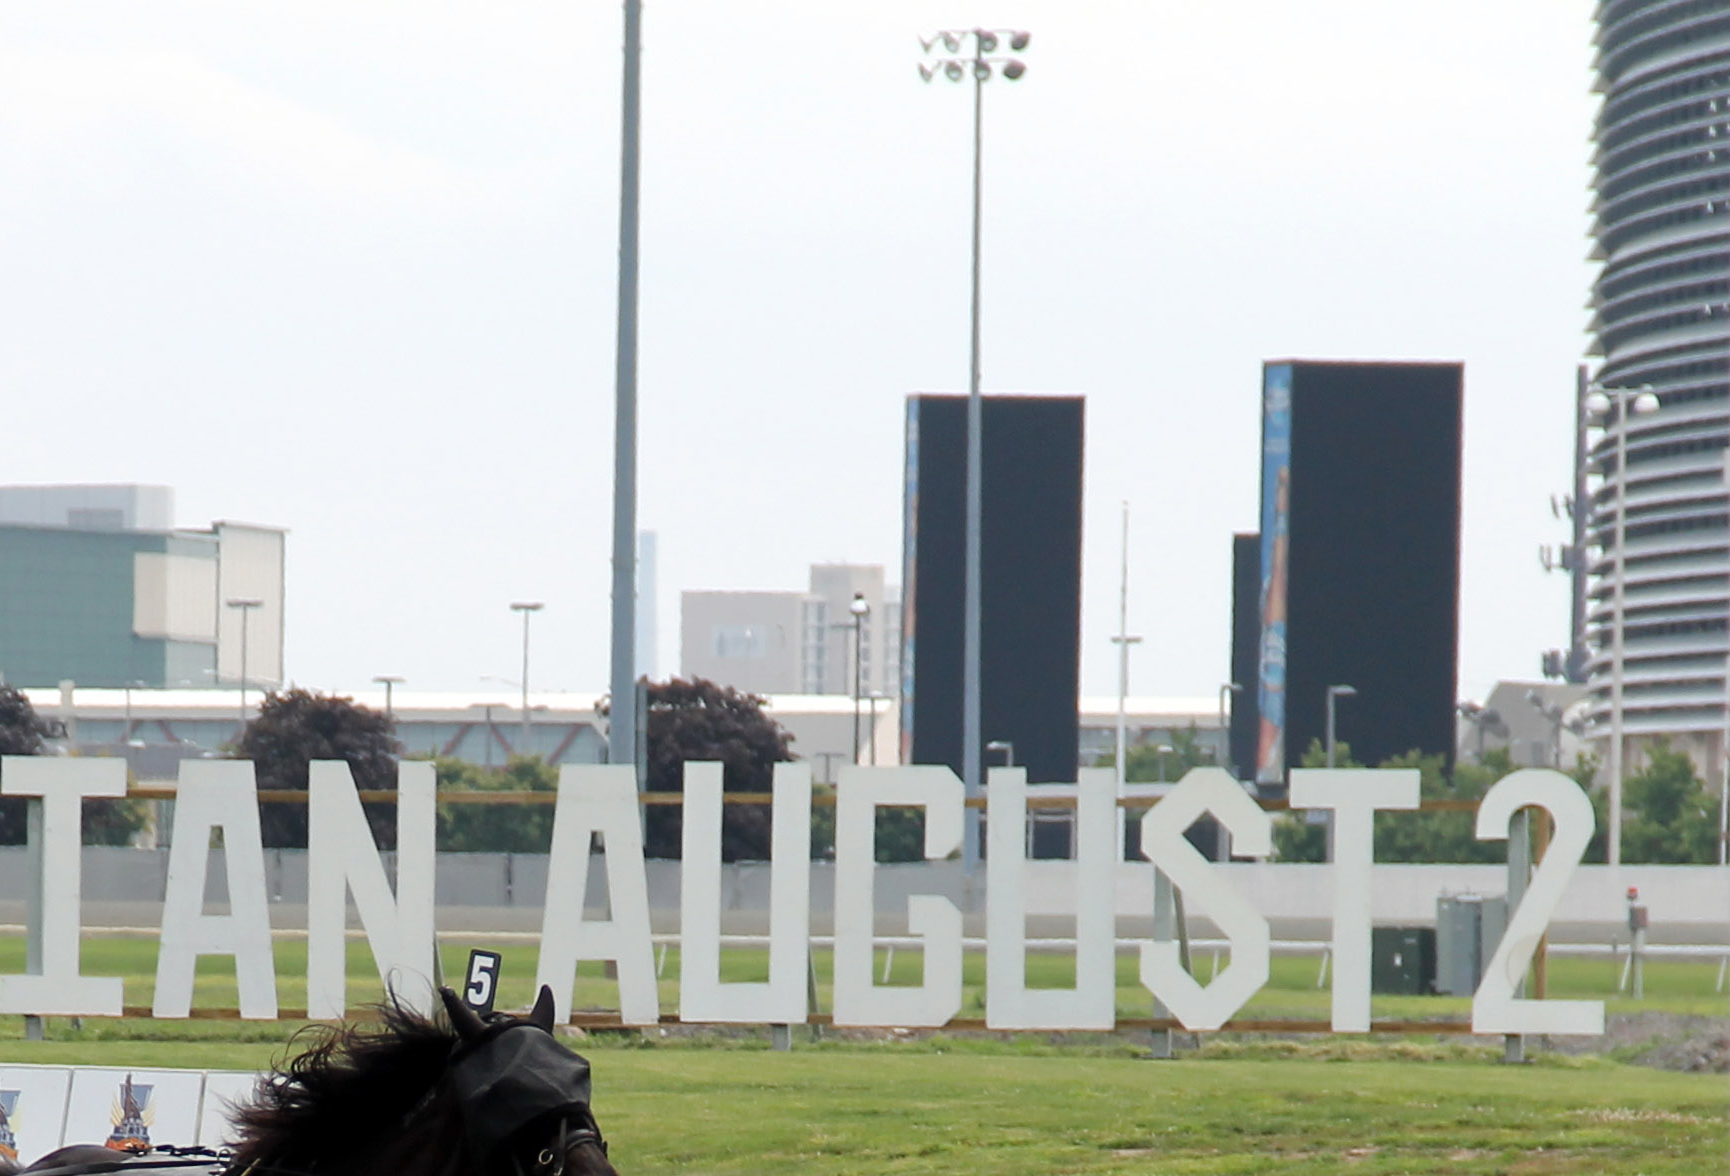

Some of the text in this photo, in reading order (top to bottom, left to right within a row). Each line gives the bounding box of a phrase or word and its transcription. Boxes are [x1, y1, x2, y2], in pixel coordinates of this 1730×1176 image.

[533, 760, 1421, 1032] AUGUST
[1470, 767, 1605, 1035] 2
[467, 954, 495, 1006] 5
